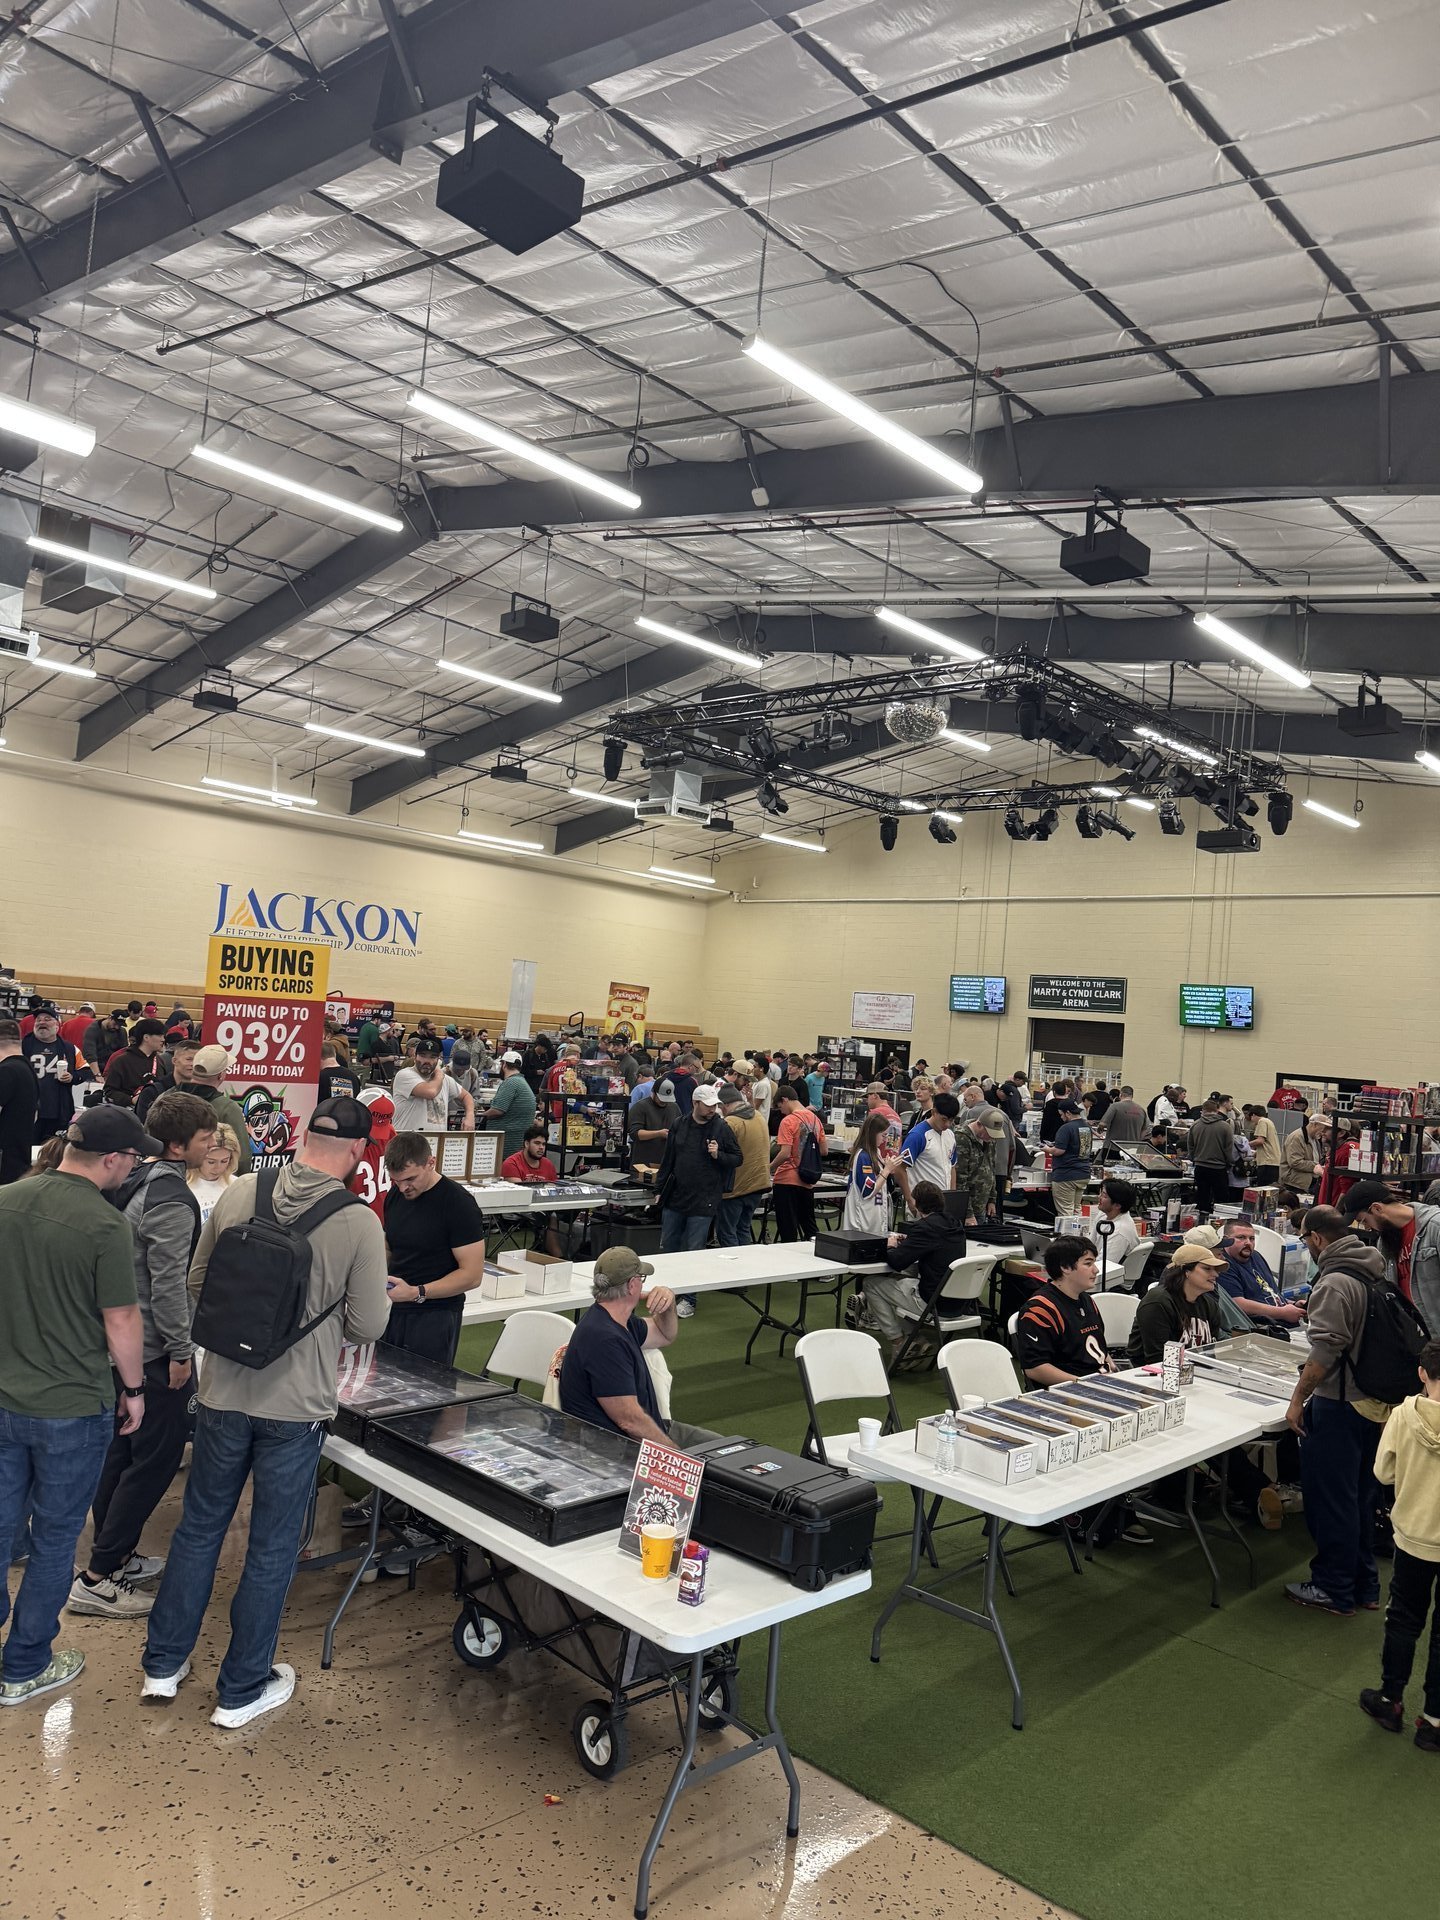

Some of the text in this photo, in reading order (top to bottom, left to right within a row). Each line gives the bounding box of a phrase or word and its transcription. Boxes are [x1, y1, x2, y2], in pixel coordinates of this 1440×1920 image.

[212, 883, 423, 950] JACKSON
[354, 942, 417, 957] CORPORATION
[220, 944, 314, 977] BUYING
[219, 974, 313, 994] SPORTS CARDS
[1033, 988, 1122, 999] MARTY & CYNDI CLARK
[216, 1002, 309, 1021] PAYING UP TO
[1062, 999, 1089, 1007] ARENA
[216, 1020, 305, 1063] 93%
[243, 1064, 267, 1076] PAID
[271, 1065, 304, 1077] TODAY
[251, 1155, 290, 1171] BURY
[357, 1155, 393, 1204] 34
[642, 1444, 701, 1475] BUYING!!!
[639, 1454, 699, 1486] BUYING!!!
